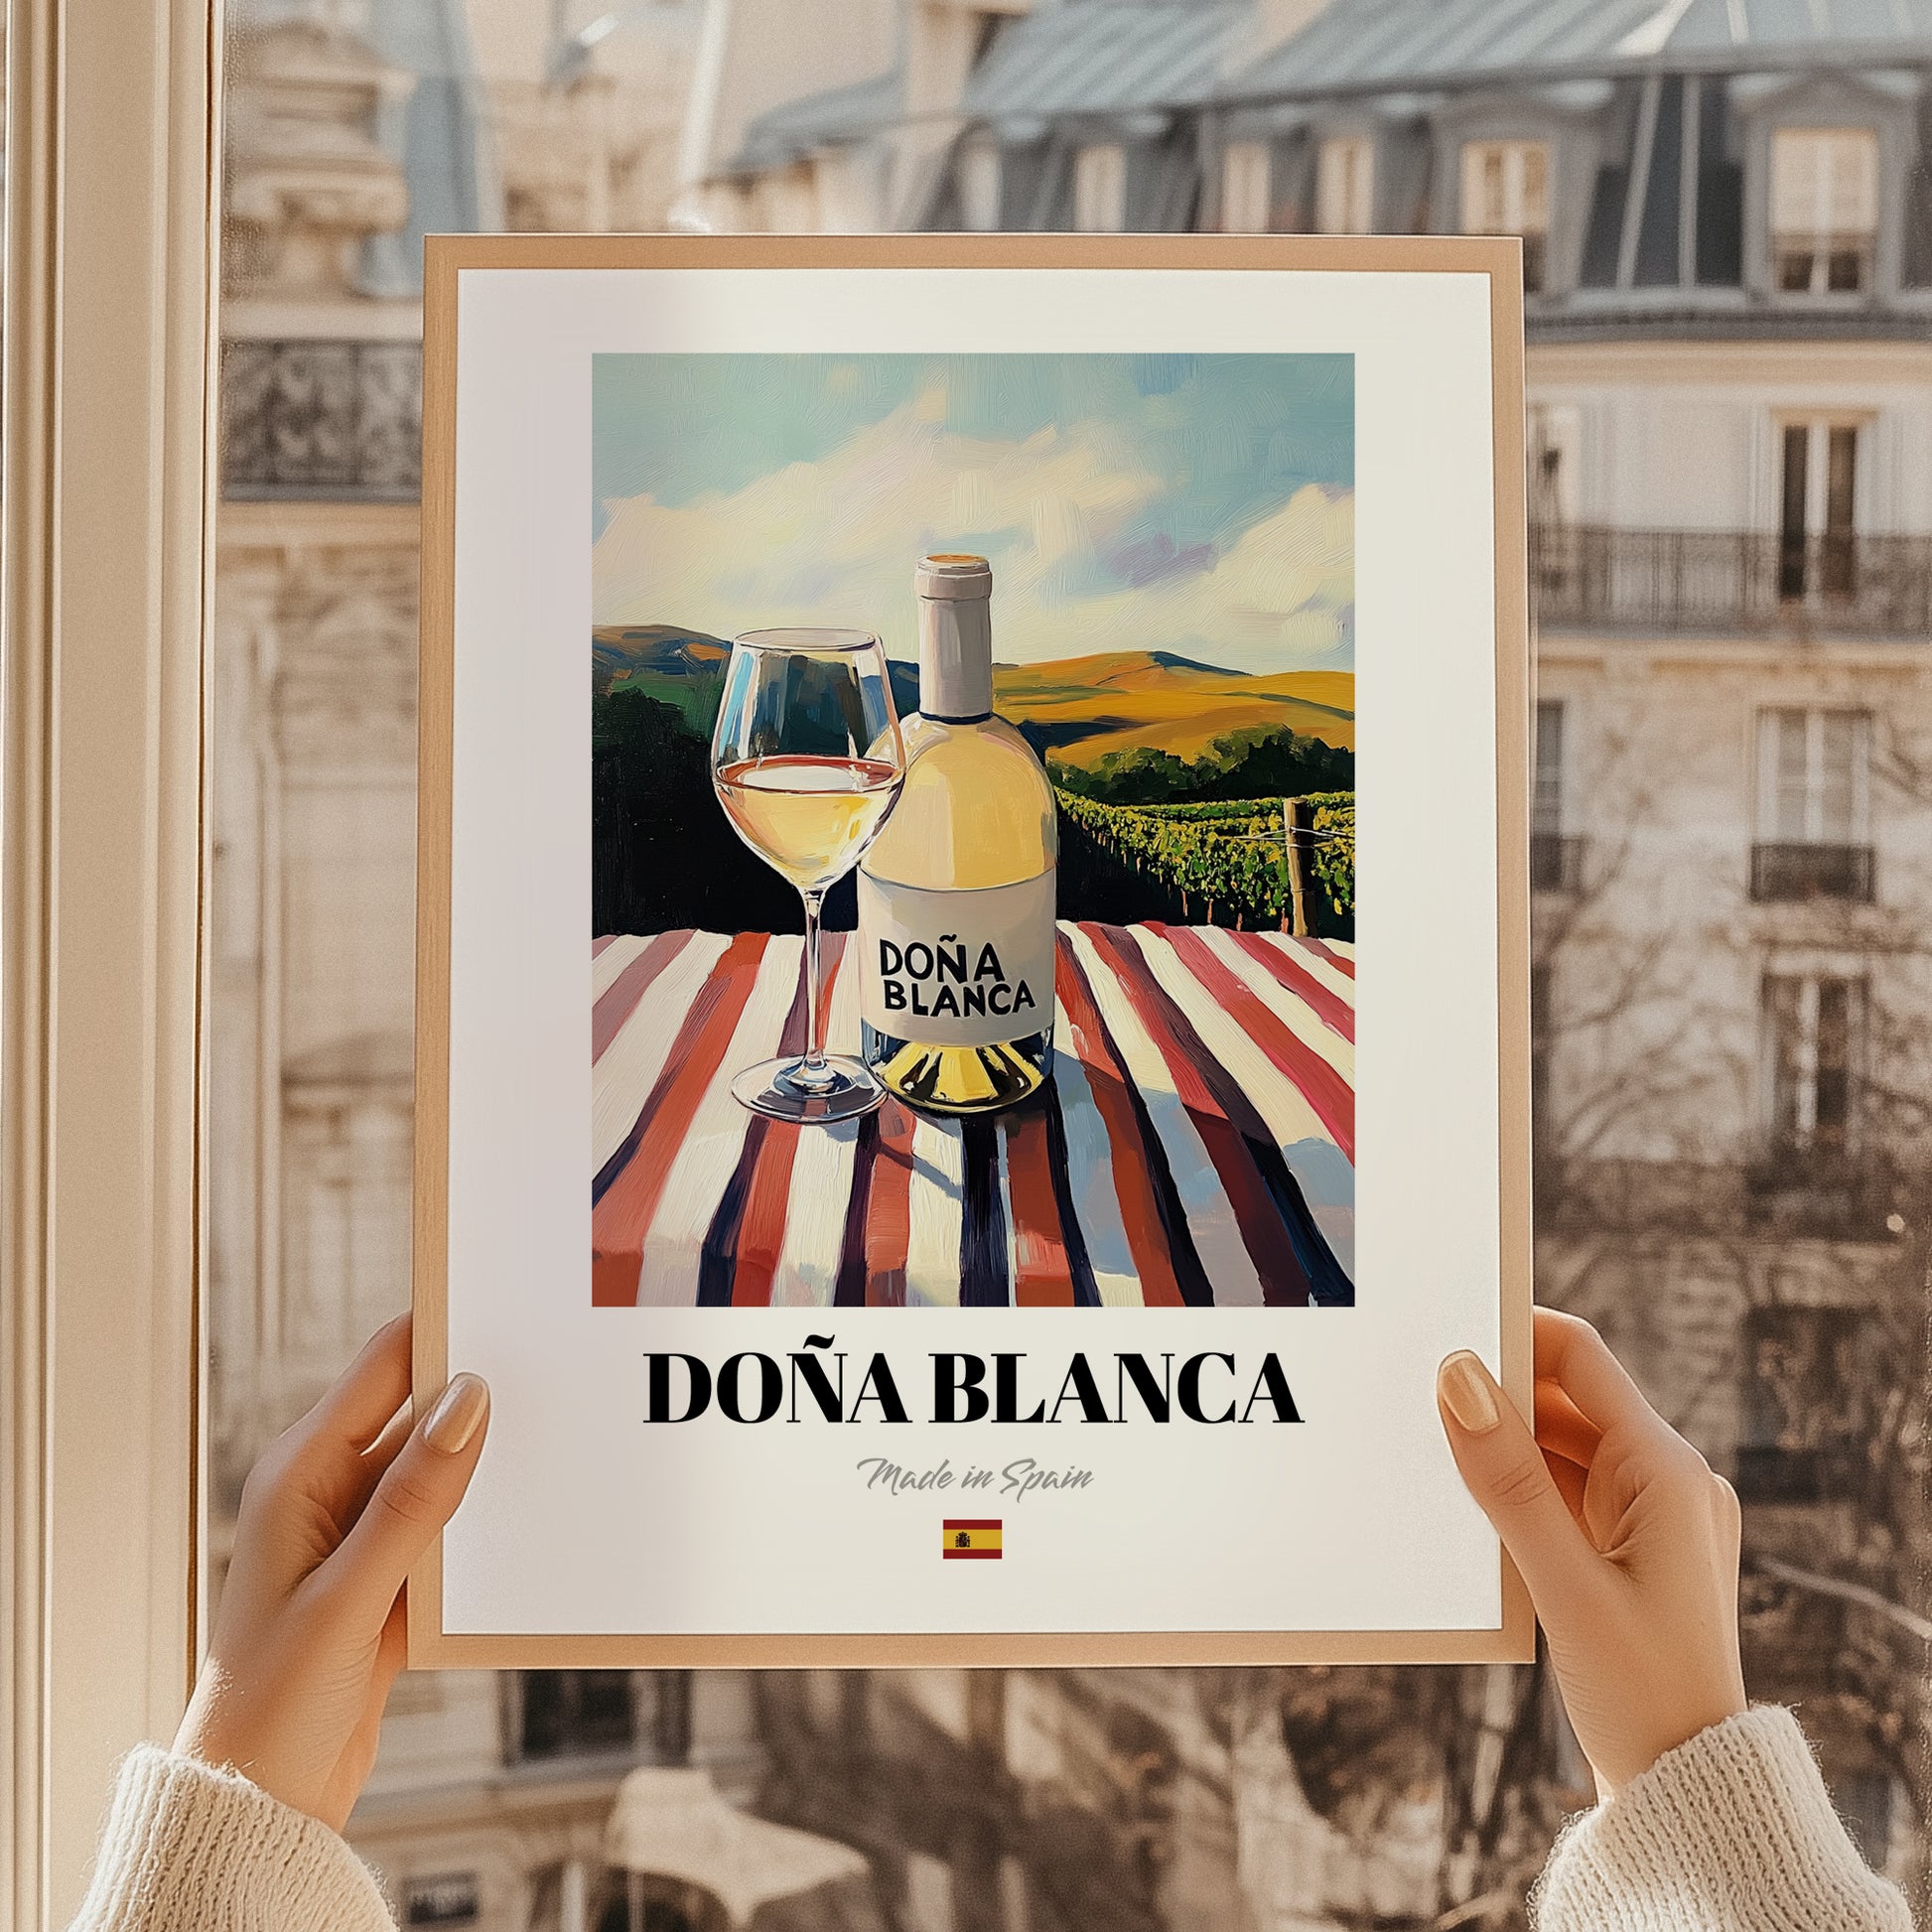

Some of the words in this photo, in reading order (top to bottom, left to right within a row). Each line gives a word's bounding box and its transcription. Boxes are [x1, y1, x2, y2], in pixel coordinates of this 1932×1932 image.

[880, 934, 1006, 985] DOÑA
[884, 979, 1036, 1018] BLANCA
[642, 1334, 913, 1424] DOÑA
[928, 1351, 1306, 1425] BLANCA
[856, 1457, 956, 1496] Made
[960, 1464, 995, 1489] in
[999, 1457, 1095, 1504] Spain
